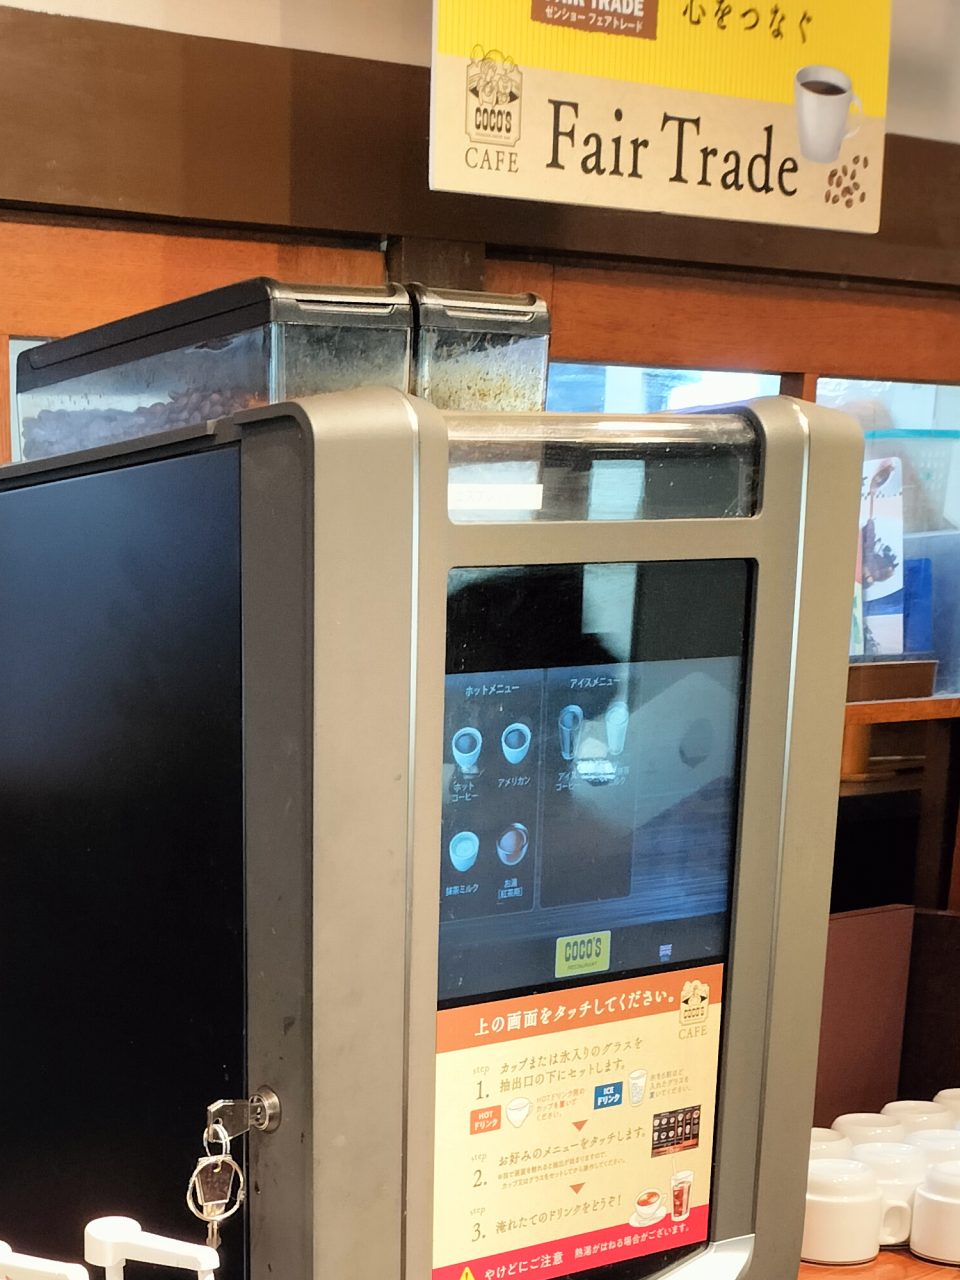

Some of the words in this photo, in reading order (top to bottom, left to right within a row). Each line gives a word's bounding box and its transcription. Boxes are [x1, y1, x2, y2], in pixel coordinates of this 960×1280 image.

[545, 5, 586, 21] ゼンショー
[588, 13, 643, 32] フェアトレード
[683, 0, 813, 44] 心をつなぐ
[474, 107, 512, 133] COCO'S
[545, 98, 649, 179] Fair
[660, 111, 799, 196] Trade
[465, 147, 519, 173] CAFE
[465, 684, 520, 697] ホットメニュー
[570, 677, 620, 688] アイスメニュー
[498, 776, 530, 788] アメリカン
[565, 937, 602, 962] COCO'S
[474, 989, 675, 1036] 上の画面をタッチしてください。
[678, 1025, 707, 1040] CAFE
[500, 1037, 643, 1074] カップまたは氷入りのグラスを
[473, 1064, 490, 1075] step
[499, 1057, 626, 1094] 抽出口の下にセットします。
[475, 1080, 490, 1101] 1.
[597, 1094, 621, 1106] ドリンク
[603, 1086, 614, 1095] ICE
[478, 1110, 494, 1120] HOT
[474, 1119, 499, 1131] ドリンク
[498, 1126, 646, 1167] お好みのメニューをタッチします。
[471, 1152, 487, 1162] step
[472, 1169, 488, 1187] 2.
[470, 1207, 486, 1216] step
[471, 1223, 486, 1242] 3.
[484, 1251, 563, 1280] やけどにご注意
[574, 1224, 689, 1259] 熱湯がはねる場合がございます。
